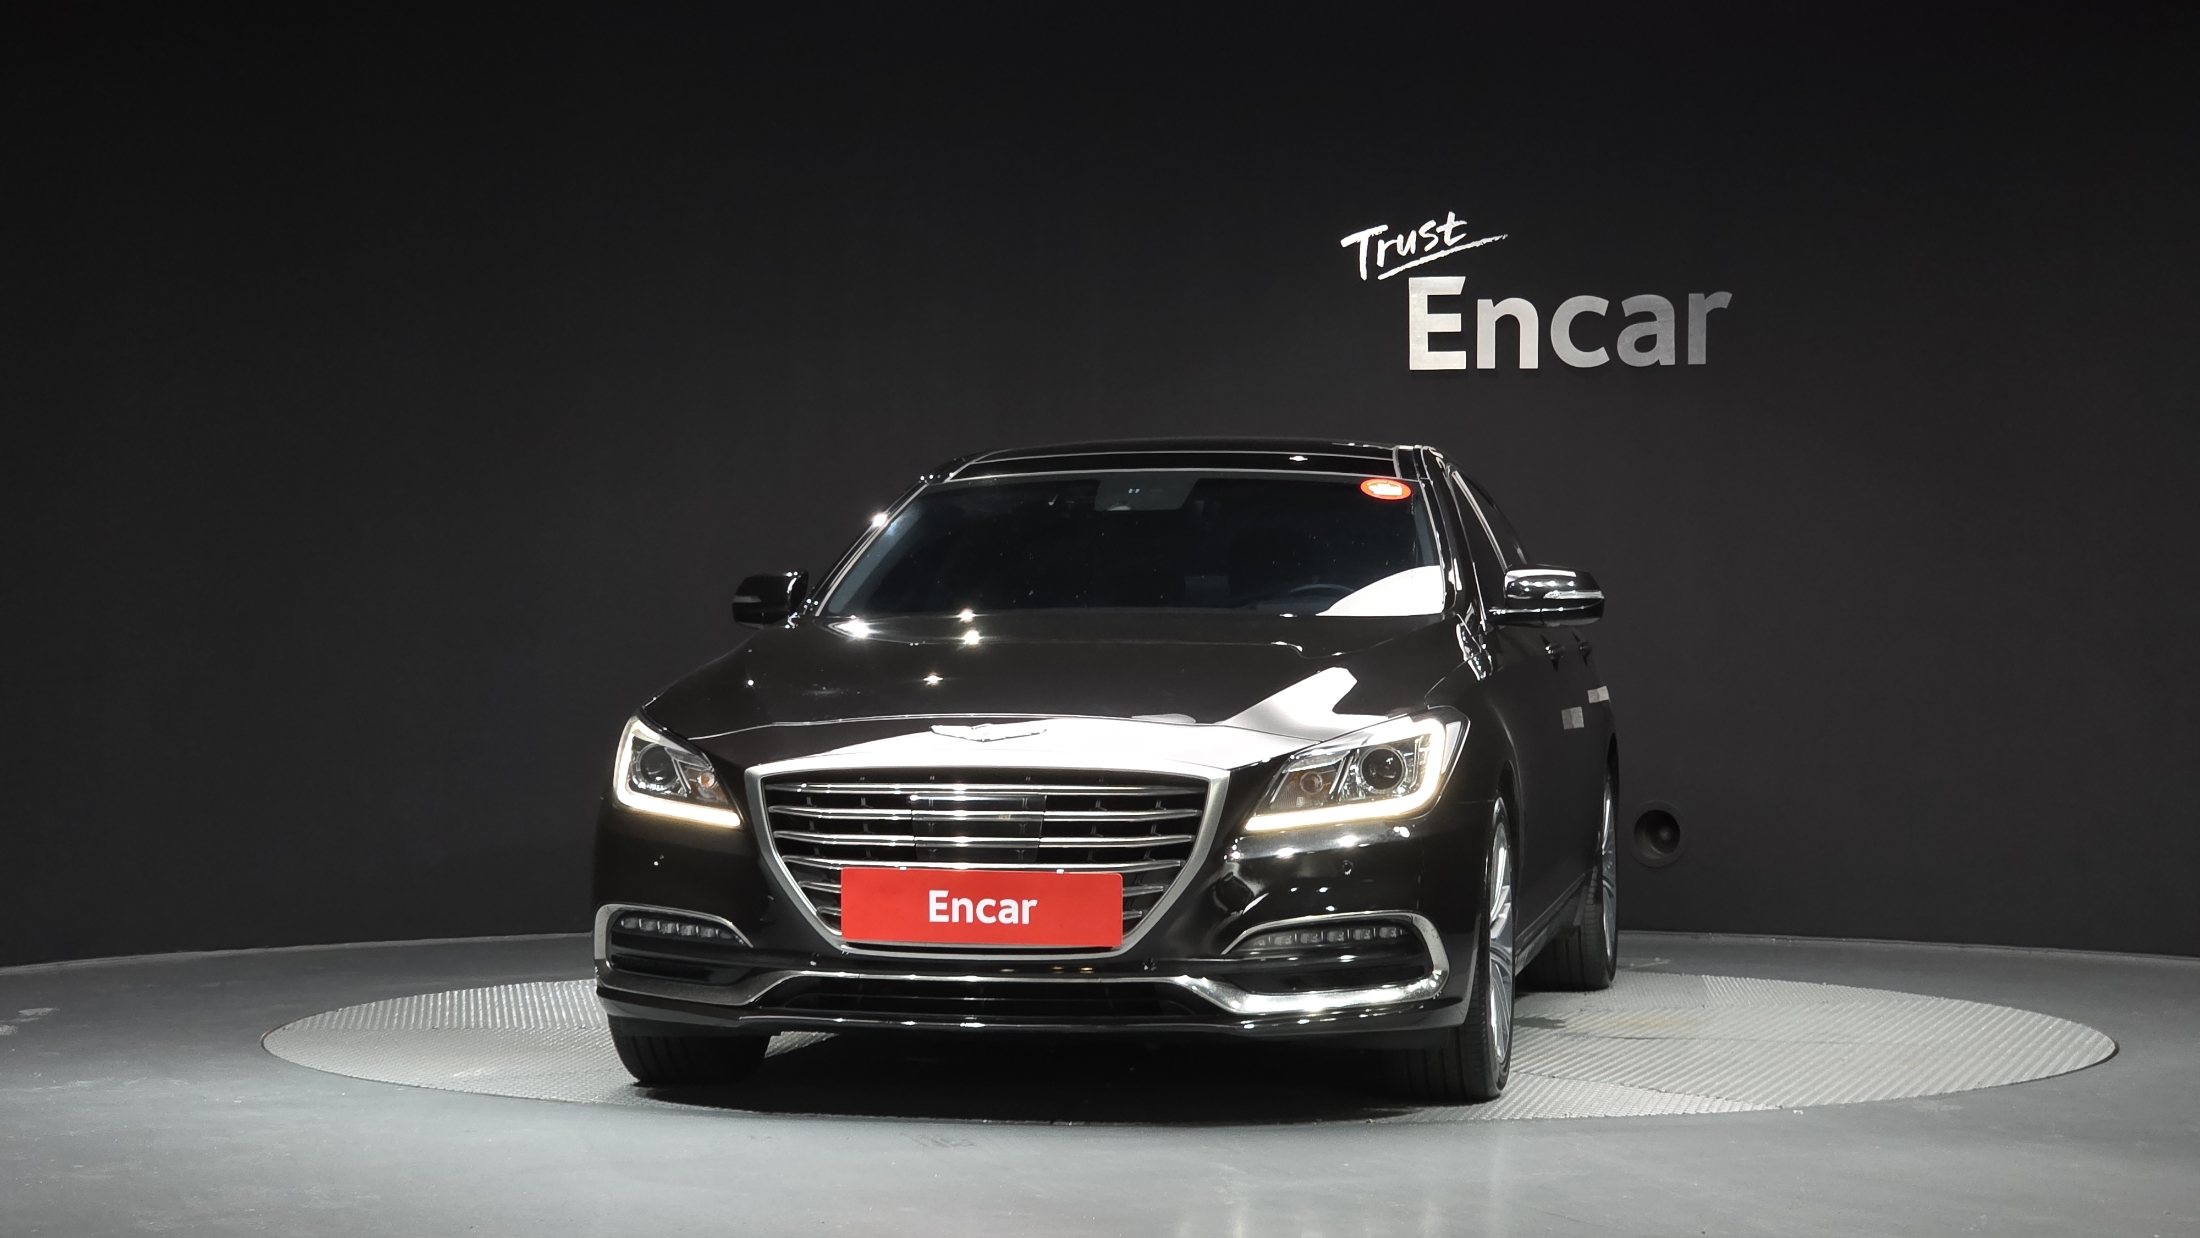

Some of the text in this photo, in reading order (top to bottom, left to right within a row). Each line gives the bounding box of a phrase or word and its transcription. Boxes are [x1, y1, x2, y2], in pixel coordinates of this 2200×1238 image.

[1340, 211, 1468, 281] Trust
[1408, 275, 1733, 370] Encar
[928, 889, 1038, 925] Encar
